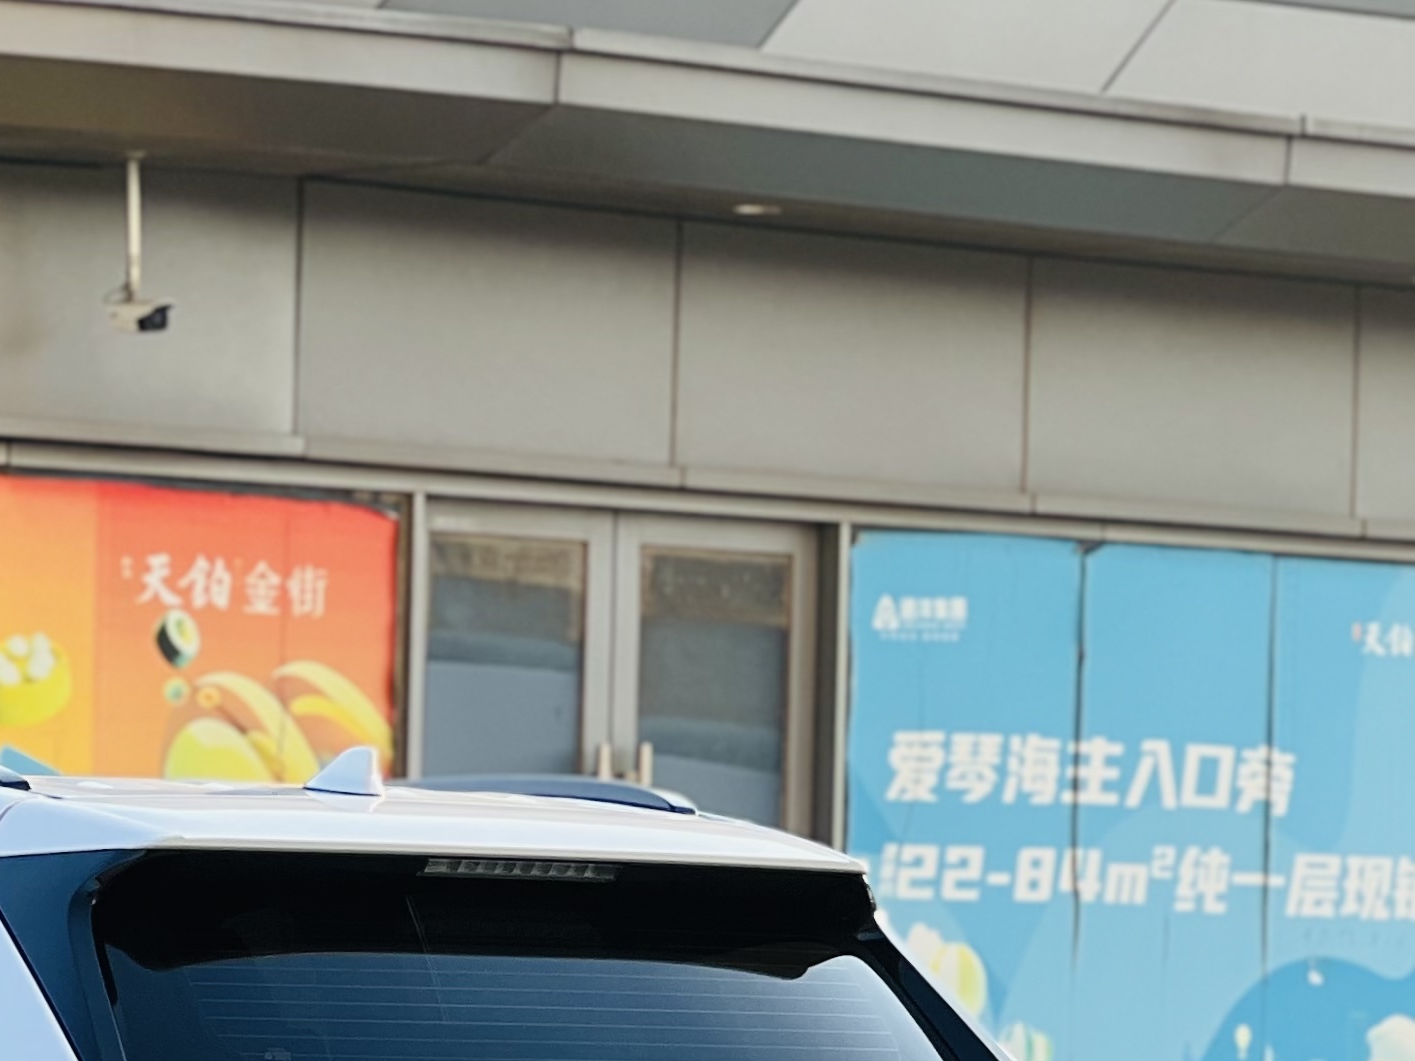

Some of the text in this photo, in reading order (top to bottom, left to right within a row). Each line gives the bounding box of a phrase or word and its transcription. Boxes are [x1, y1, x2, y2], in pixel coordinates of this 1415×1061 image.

[886, 729, 1296, 817] 爱琴海主入口旁
